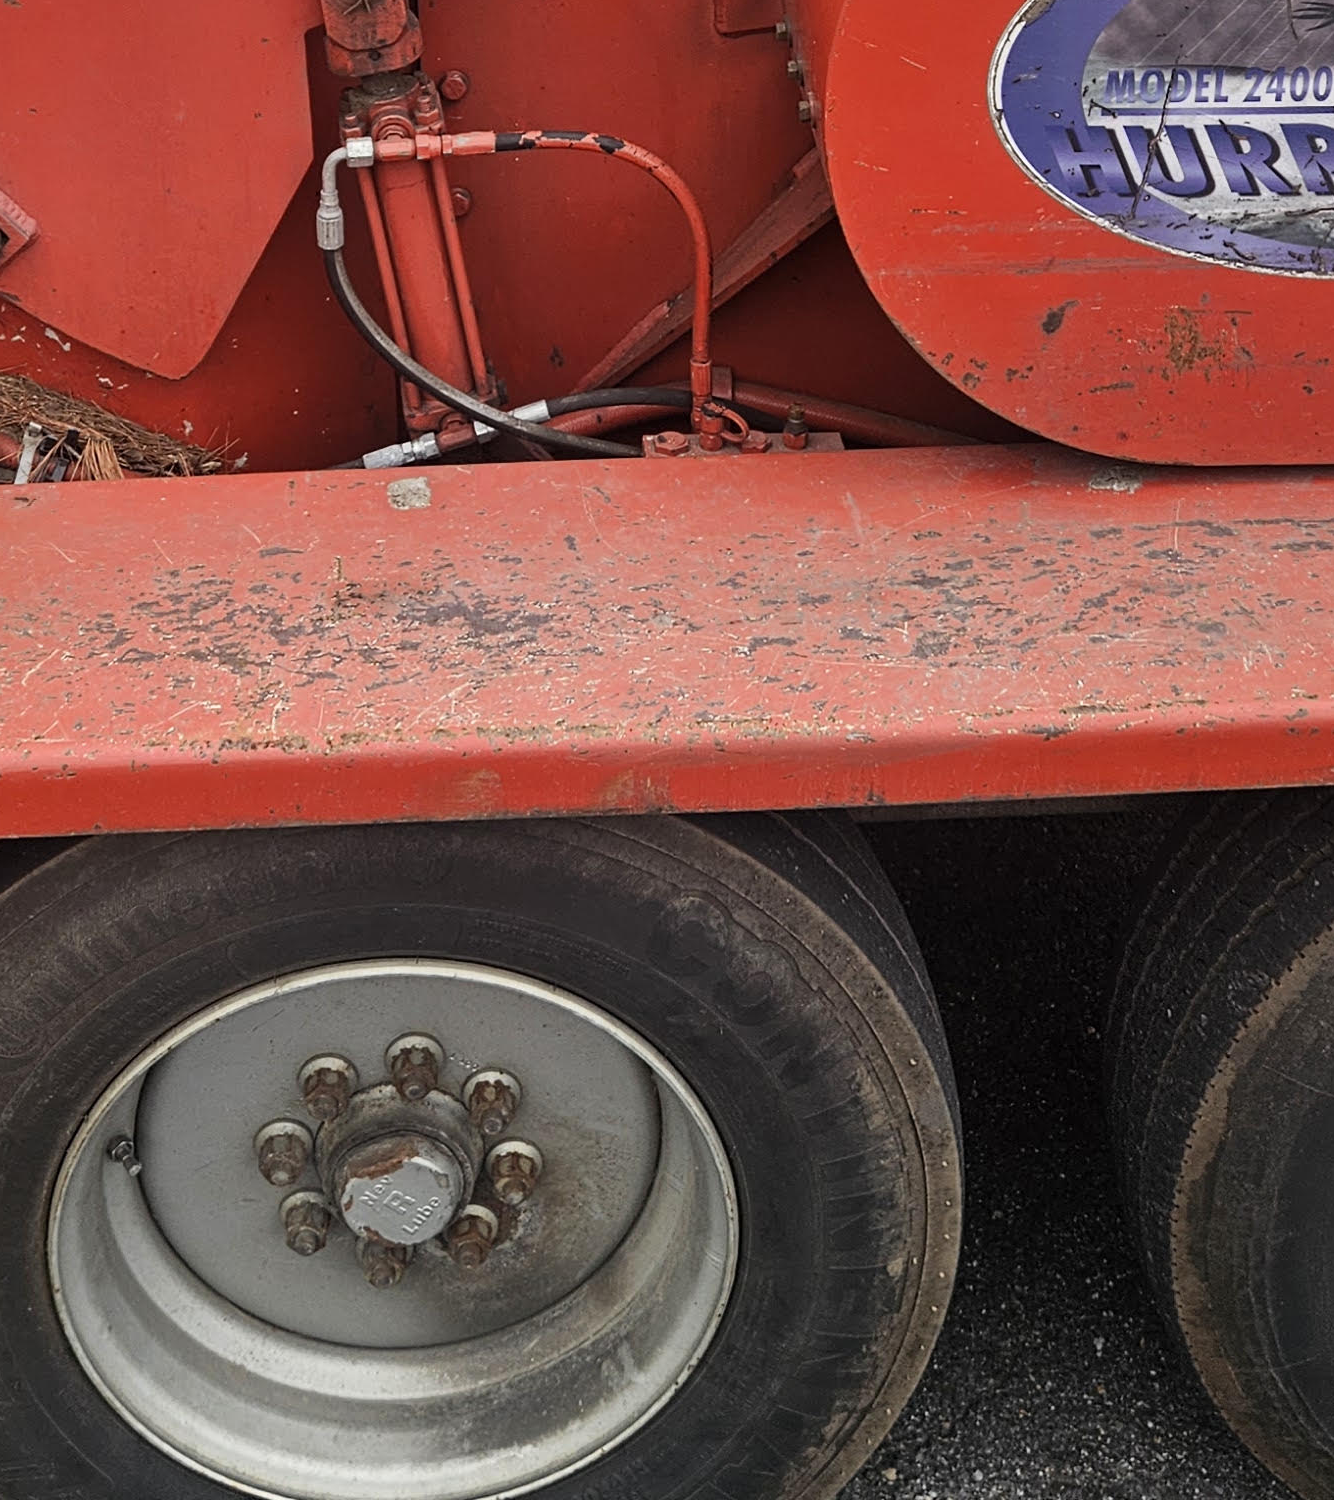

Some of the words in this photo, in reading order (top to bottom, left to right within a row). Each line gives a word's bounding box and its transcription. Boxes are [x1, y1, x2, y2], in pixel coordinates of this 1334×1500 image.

[1103, 67, 1229, 104] MODEL
[1244, 66, 1334, 103] 2400
[402, 1196, 441, 1235] Lube
